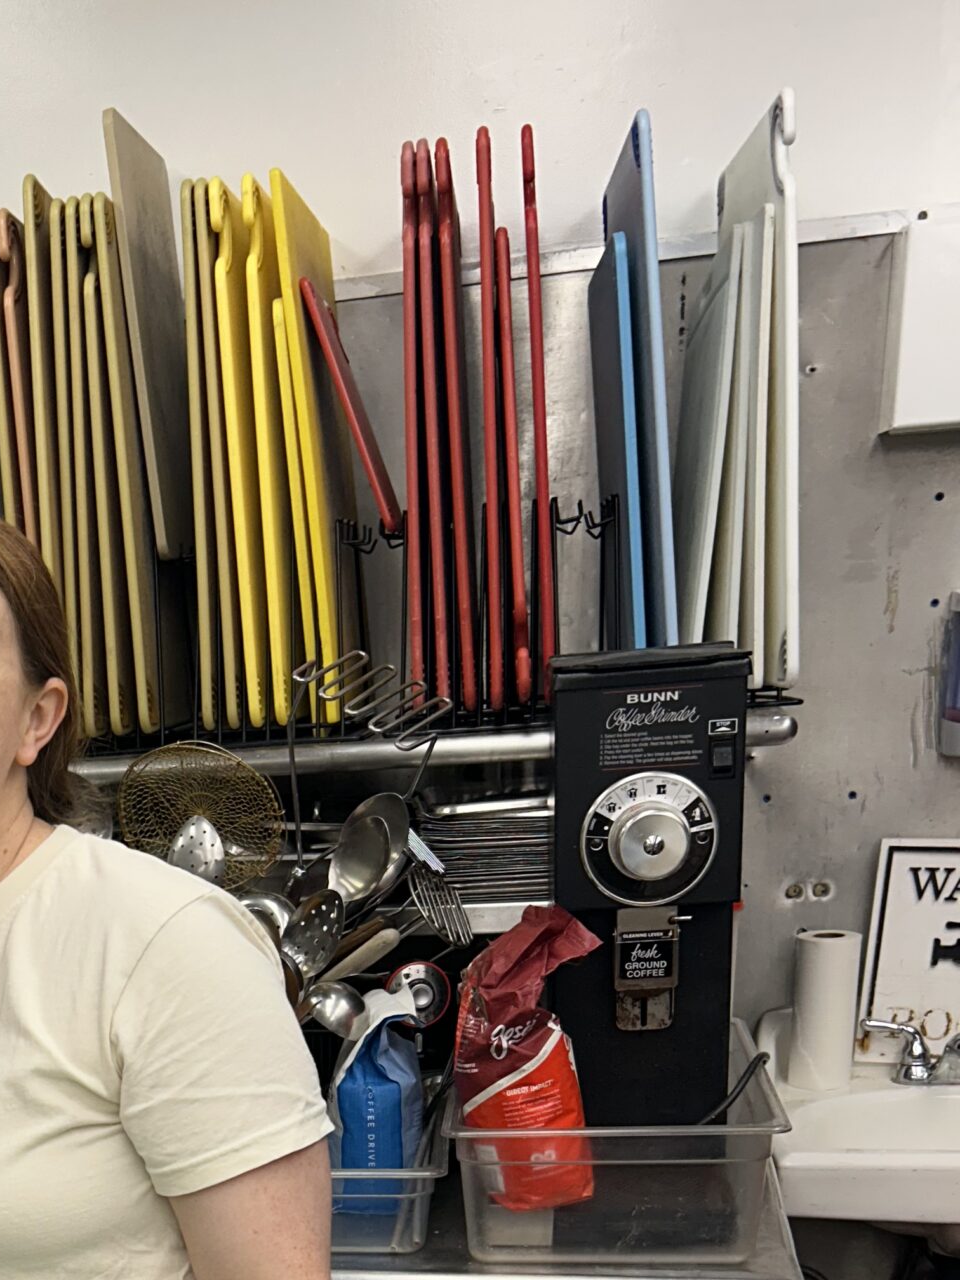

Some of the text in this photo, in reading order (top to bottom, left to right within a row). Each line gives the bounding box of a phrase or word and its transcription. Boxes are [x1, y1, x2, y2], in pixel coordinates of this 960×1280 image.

[626, 690, 680, 704] BUNN
[606, 702, 700, 732] Coffee Grinder
[630, 943, 662, 962] fresh
[624, 960, 668, 970] GROUND
[626, 968, 665, 978] COFFEE
